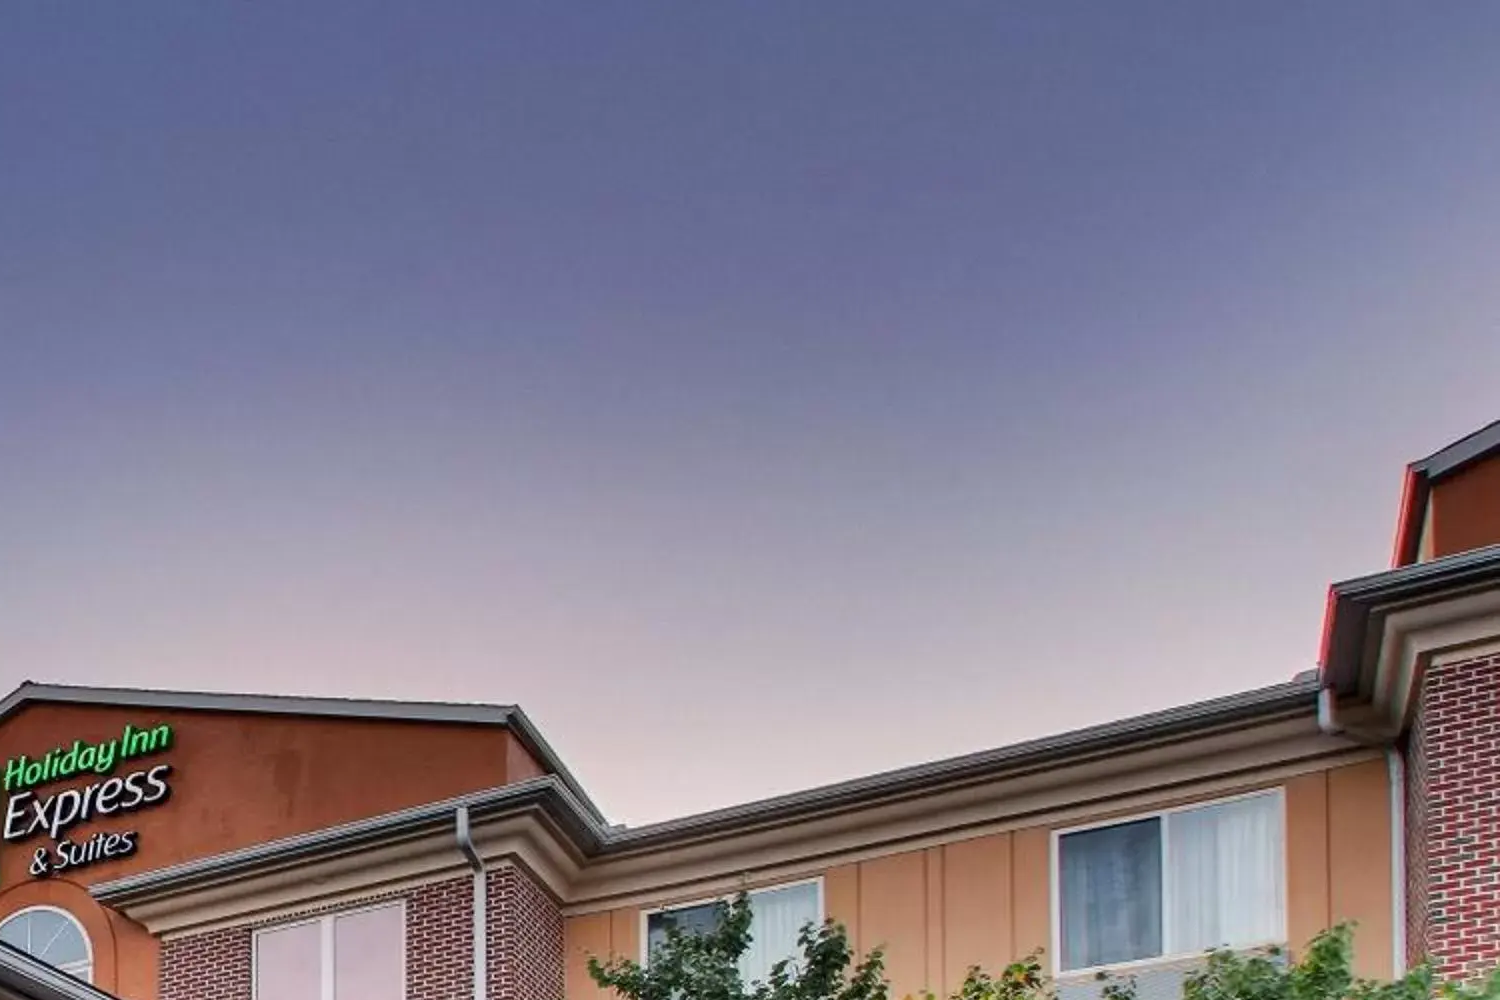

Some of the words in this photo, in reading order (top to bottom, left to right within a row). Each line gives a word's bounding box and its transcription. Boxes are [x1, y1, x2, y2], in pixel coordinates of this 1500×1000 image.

[4, 742, 116, 789] Holiday
[122, 725, 170, 757] Inn
[4, 765, 169, 839] Express
[29, 847, 48, 875] &
[54, 831, 134, 870] Suites
